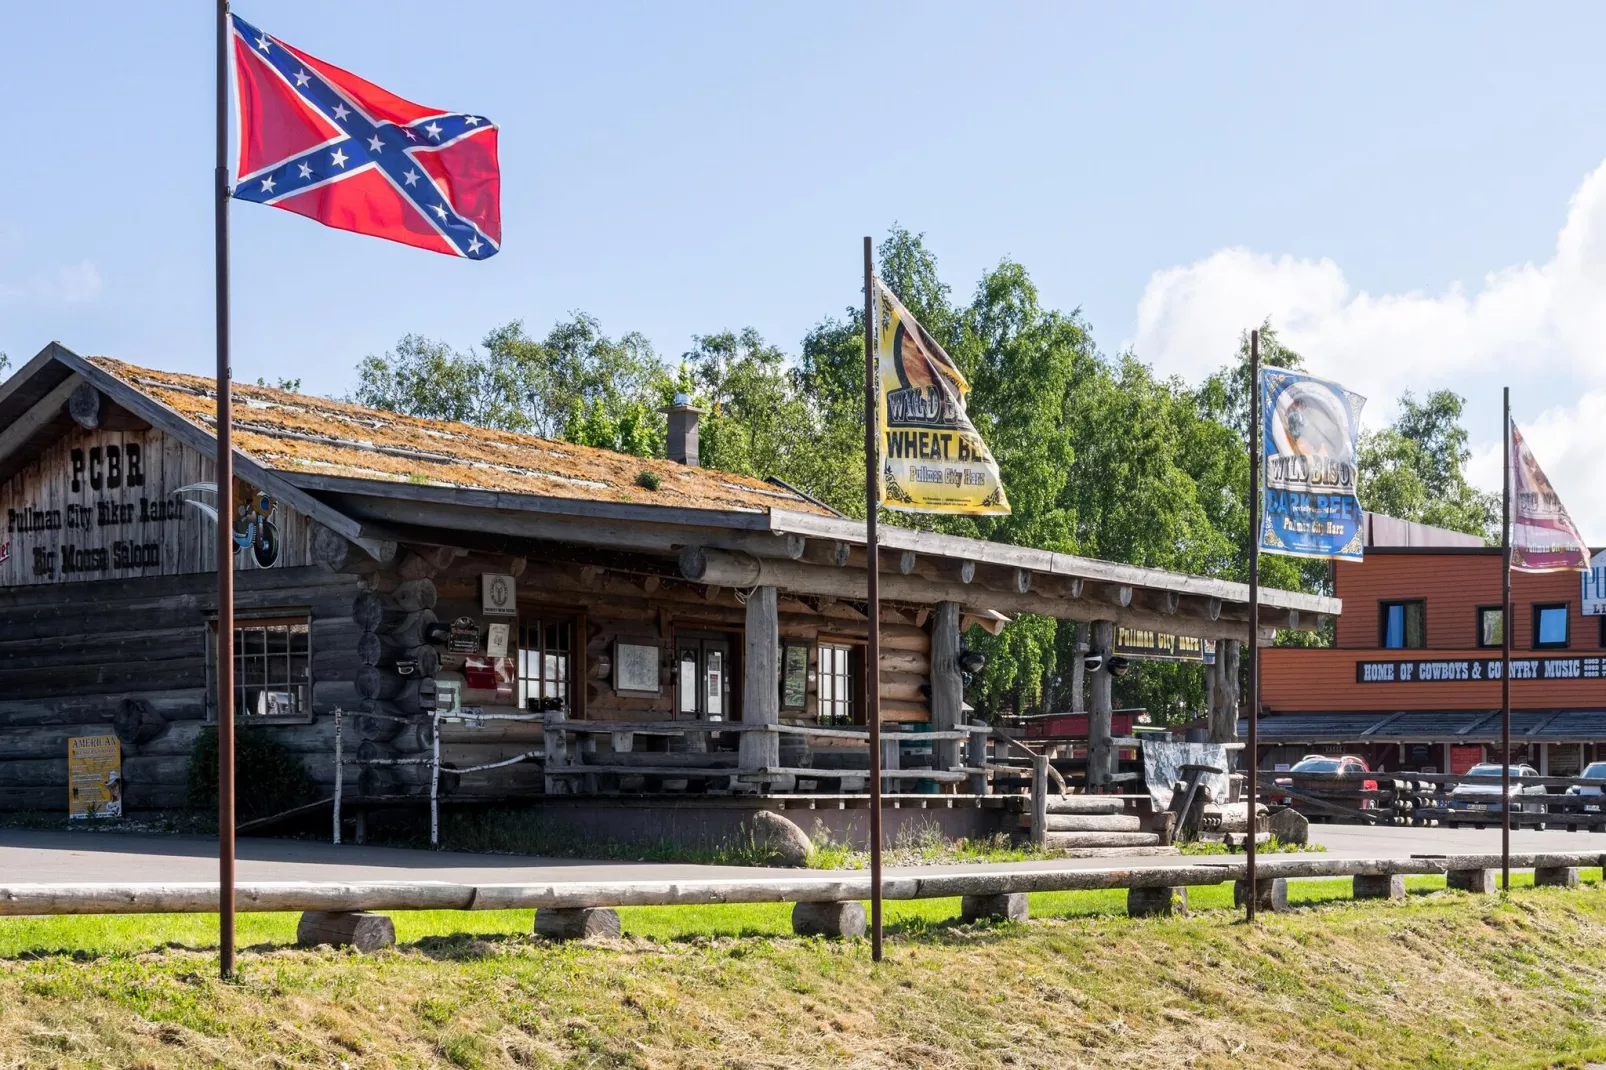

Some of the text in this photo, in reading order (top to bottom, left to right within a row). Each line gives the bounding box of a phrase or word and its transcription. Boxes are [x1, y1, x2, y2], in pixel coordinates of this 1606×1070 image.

[888, 385, 940, 423] WILD
[886, 430, 952, 459] WHEAT
[70, 442, 145, 492] PCBR
[909, 466, 985, 488] Pullman City Harz
[1271, 455, 1353, 487] WILD BISO
[7, 493, 185, 533] Pullman City Biker Ranch
[1267, 489, 1357, 521] DARK BEE
[1311, 521, 1324, 536] City
[1326, 521, 1344, 535] Harz
[32, 546, 56, 580] Big
[113, 540, 160, 570] Saloon
[1118, 627, 1155, 648] Pullman
[1157, 633, 1176, 655] City
[1363, 659, 1581, 681] HOME OF COWBOYS & CONTRY MUSIC
[73, 737, 116, 749] AMERICAN
